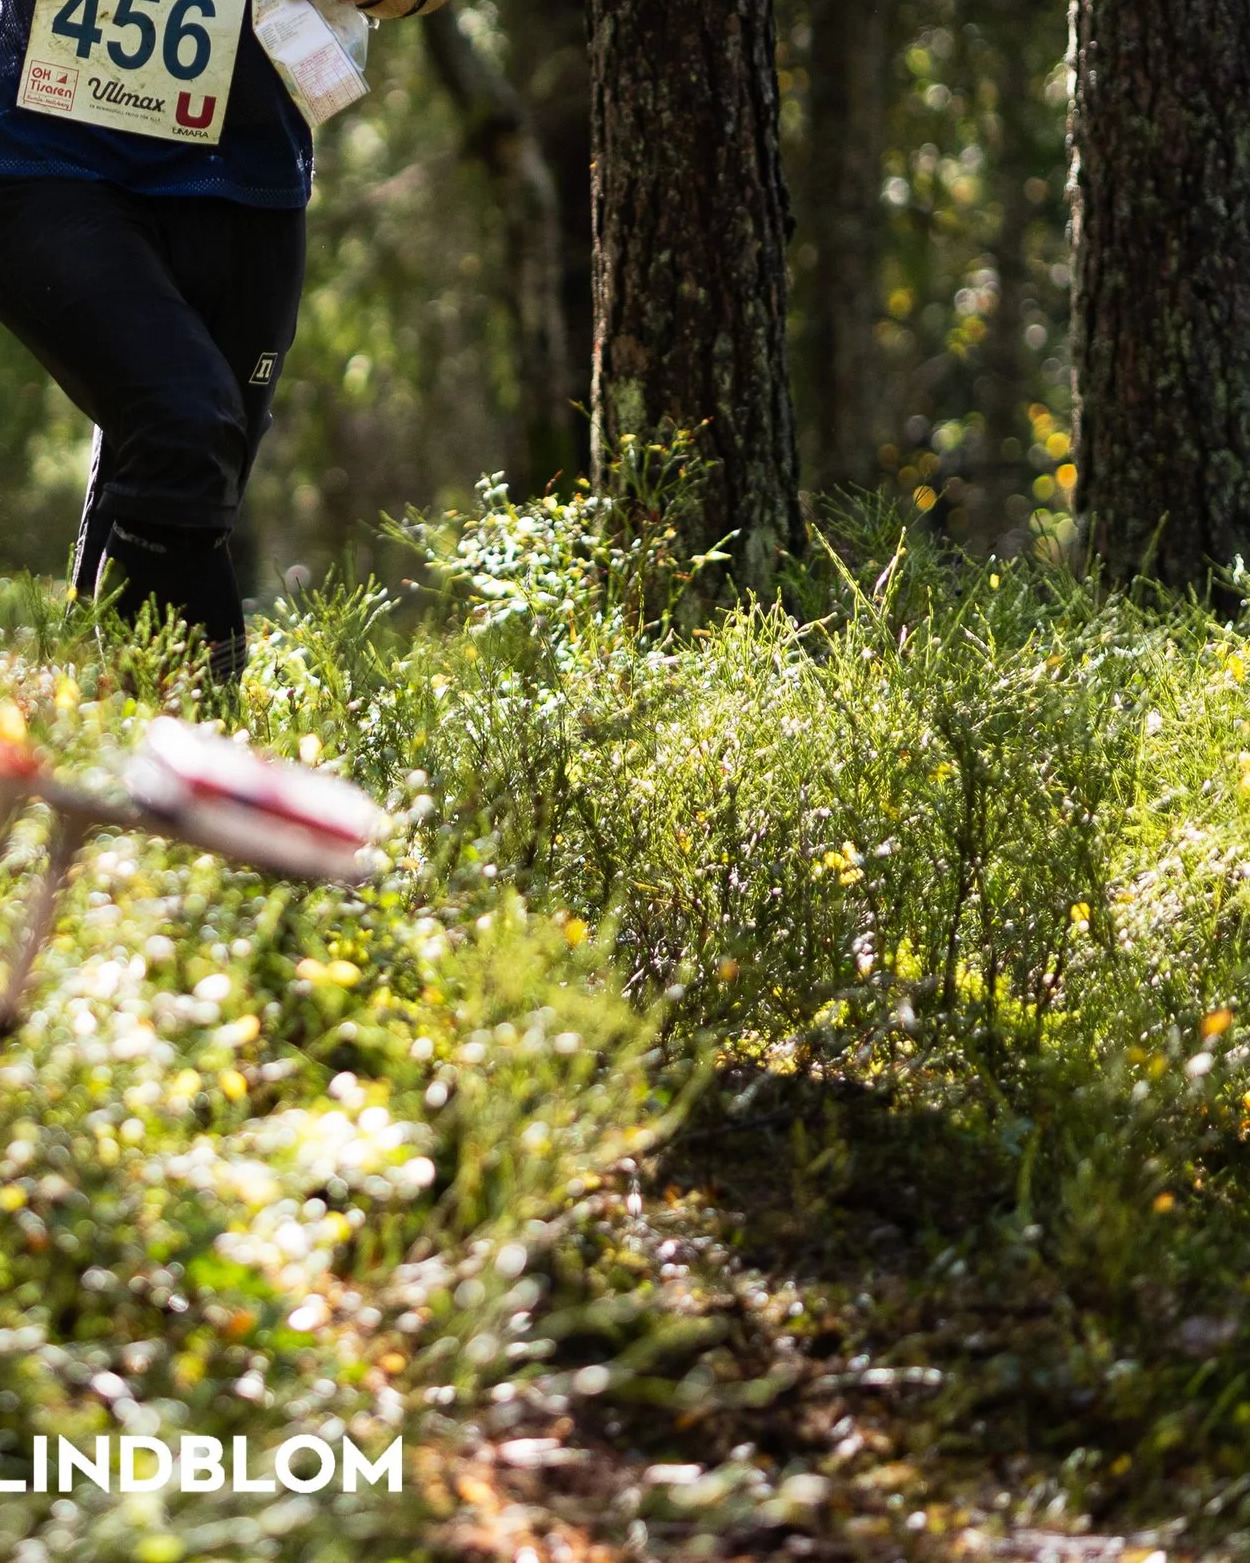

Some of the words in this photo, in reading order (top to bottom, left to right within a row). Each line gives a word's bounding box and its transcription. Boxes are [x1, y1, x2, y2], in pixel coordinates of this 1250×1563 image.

[30, 78, 72, 98] Tisaren
[88, 77, 165, 113] Ullmax
[172, 126, 209, 139] UMARA
